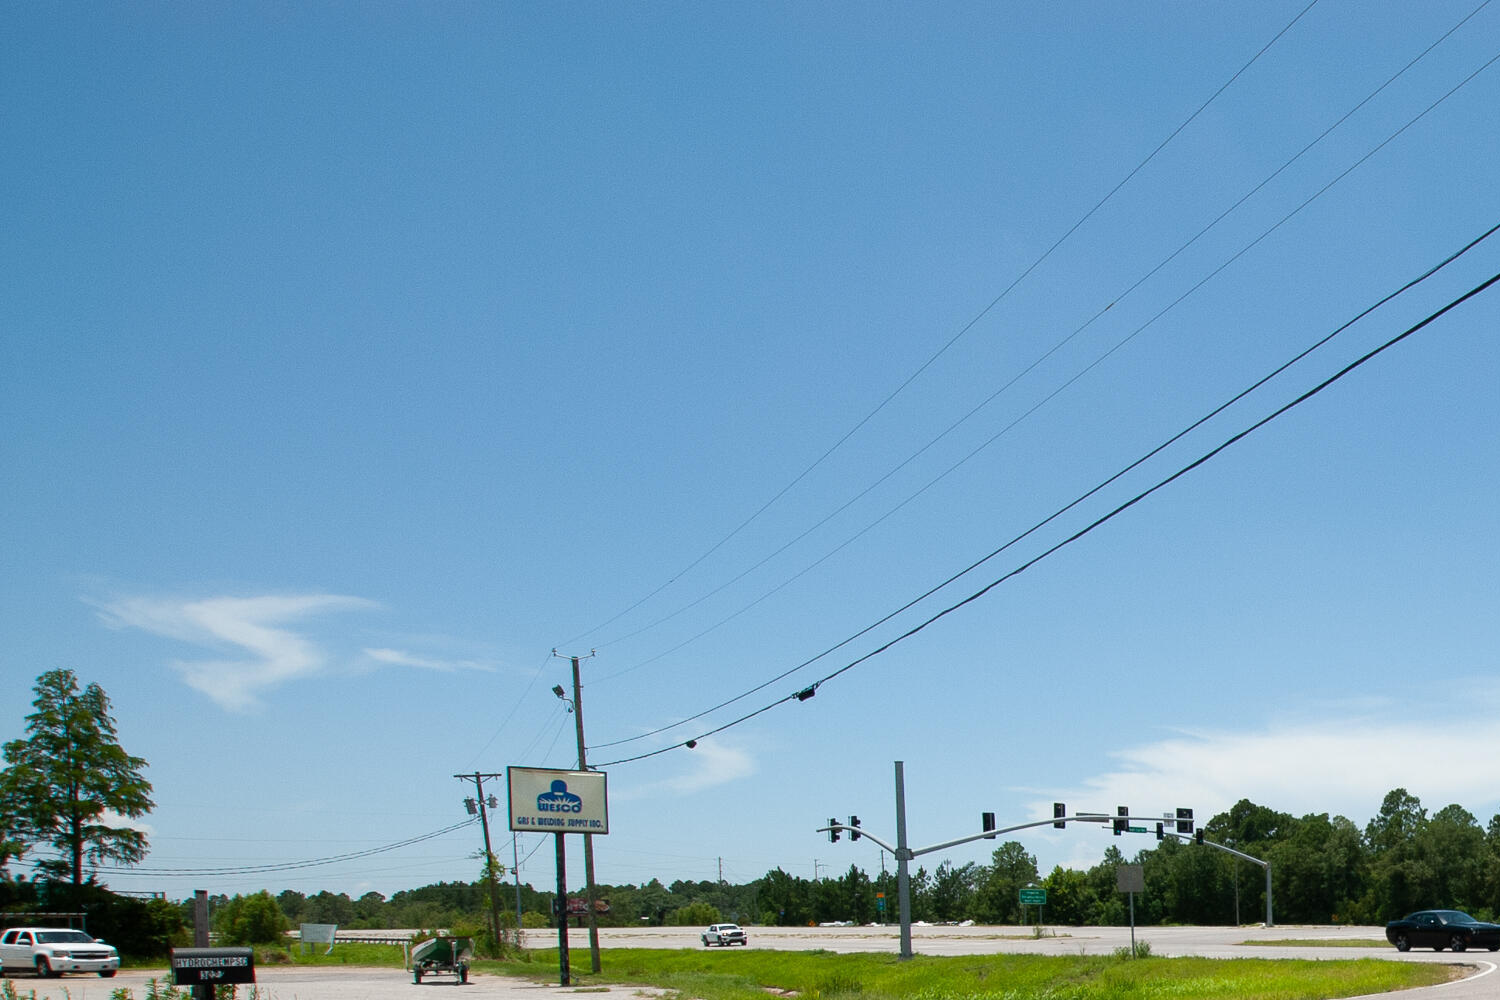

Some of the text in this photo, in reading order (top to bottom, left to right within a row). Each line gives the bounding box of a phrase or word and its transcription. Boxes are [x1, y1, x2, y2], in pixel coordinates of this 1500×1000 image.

[538, 802, 582, 814] WESCO
[517, 816, 530, 826] GAS
[538, 817, 566, 827] WELDING
[567, 818, 588, 828] SUPPLY
